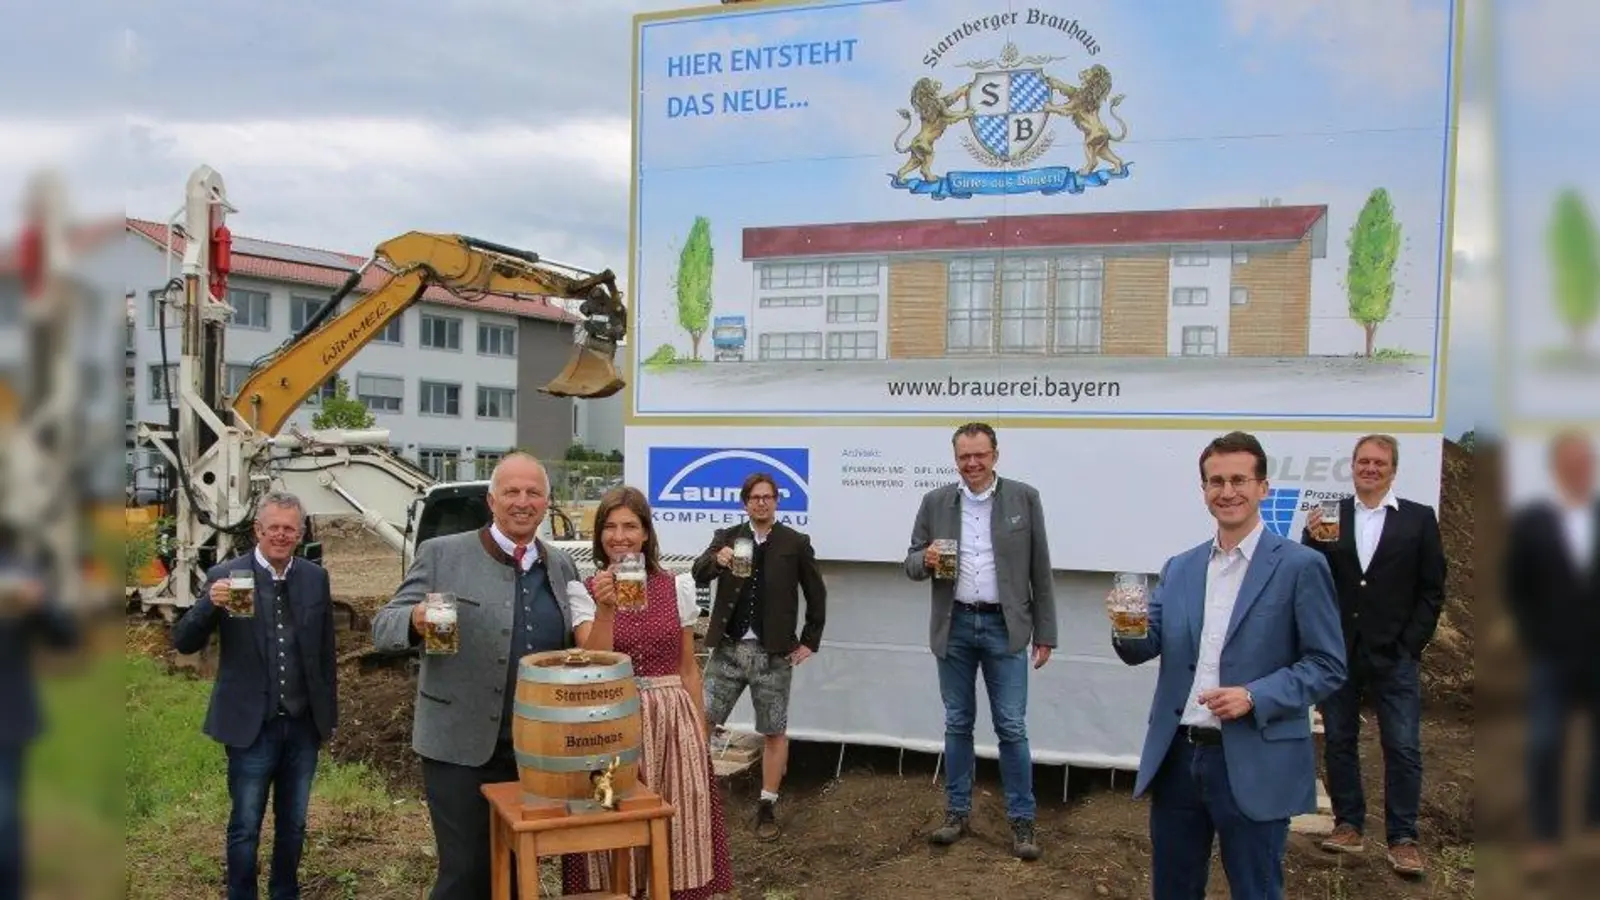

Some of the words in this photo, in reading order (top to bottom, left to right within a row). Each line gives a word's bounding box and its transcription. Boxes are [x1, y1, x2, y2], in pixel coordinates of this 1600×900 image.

[923, 11, 1019, 69] Starnberger
[1026, 8, 1101, 57] Brauhaus
[667, 52, 723, 77] HIER
[730, 39, 858, 72] ENTSTEHT
[667, 93, 715, 118] DAS
[723, 87, 809, 113] NEUE...
[981, 82, 1001, 107] S
[1014, 118, 1033, 142] B
[322, 301, 391, 365] WIMMER
[887, 376, 1121, 402] www.brauerei.bayern
[555, 686, 624, 702] Starnberger
[564, 732, 624, 748] Brauhaus
